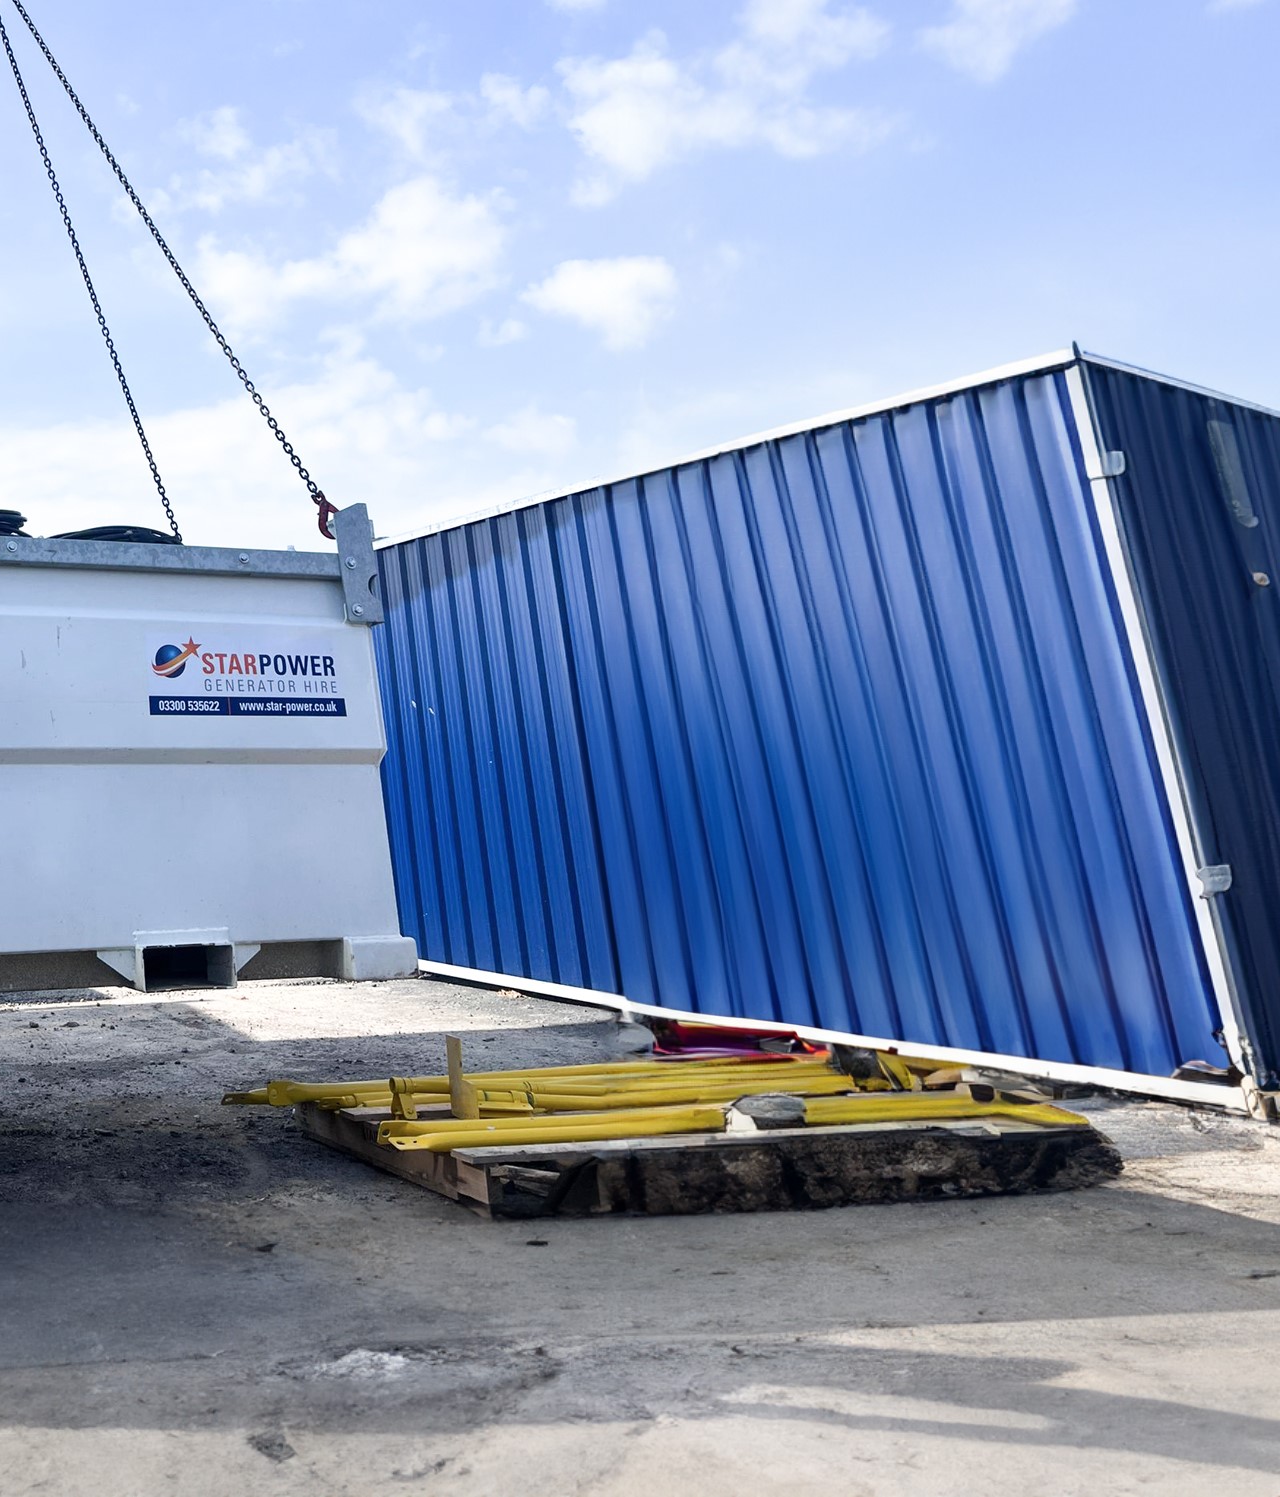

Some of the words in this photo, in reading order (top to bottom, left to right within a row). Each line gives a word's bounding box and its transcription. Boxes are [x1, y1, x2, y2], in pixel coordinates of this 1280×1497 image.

[201, 652, 336, 677] STARPOWER
[204, 678, 297, 693] GENERATOR
[304, 680, 338, 694] HIRE
[158, 700, 186, 711] 03300
[187, 700, 220, 712] 535622
[239, 700, 338, 715] www.star-power.co.uk
